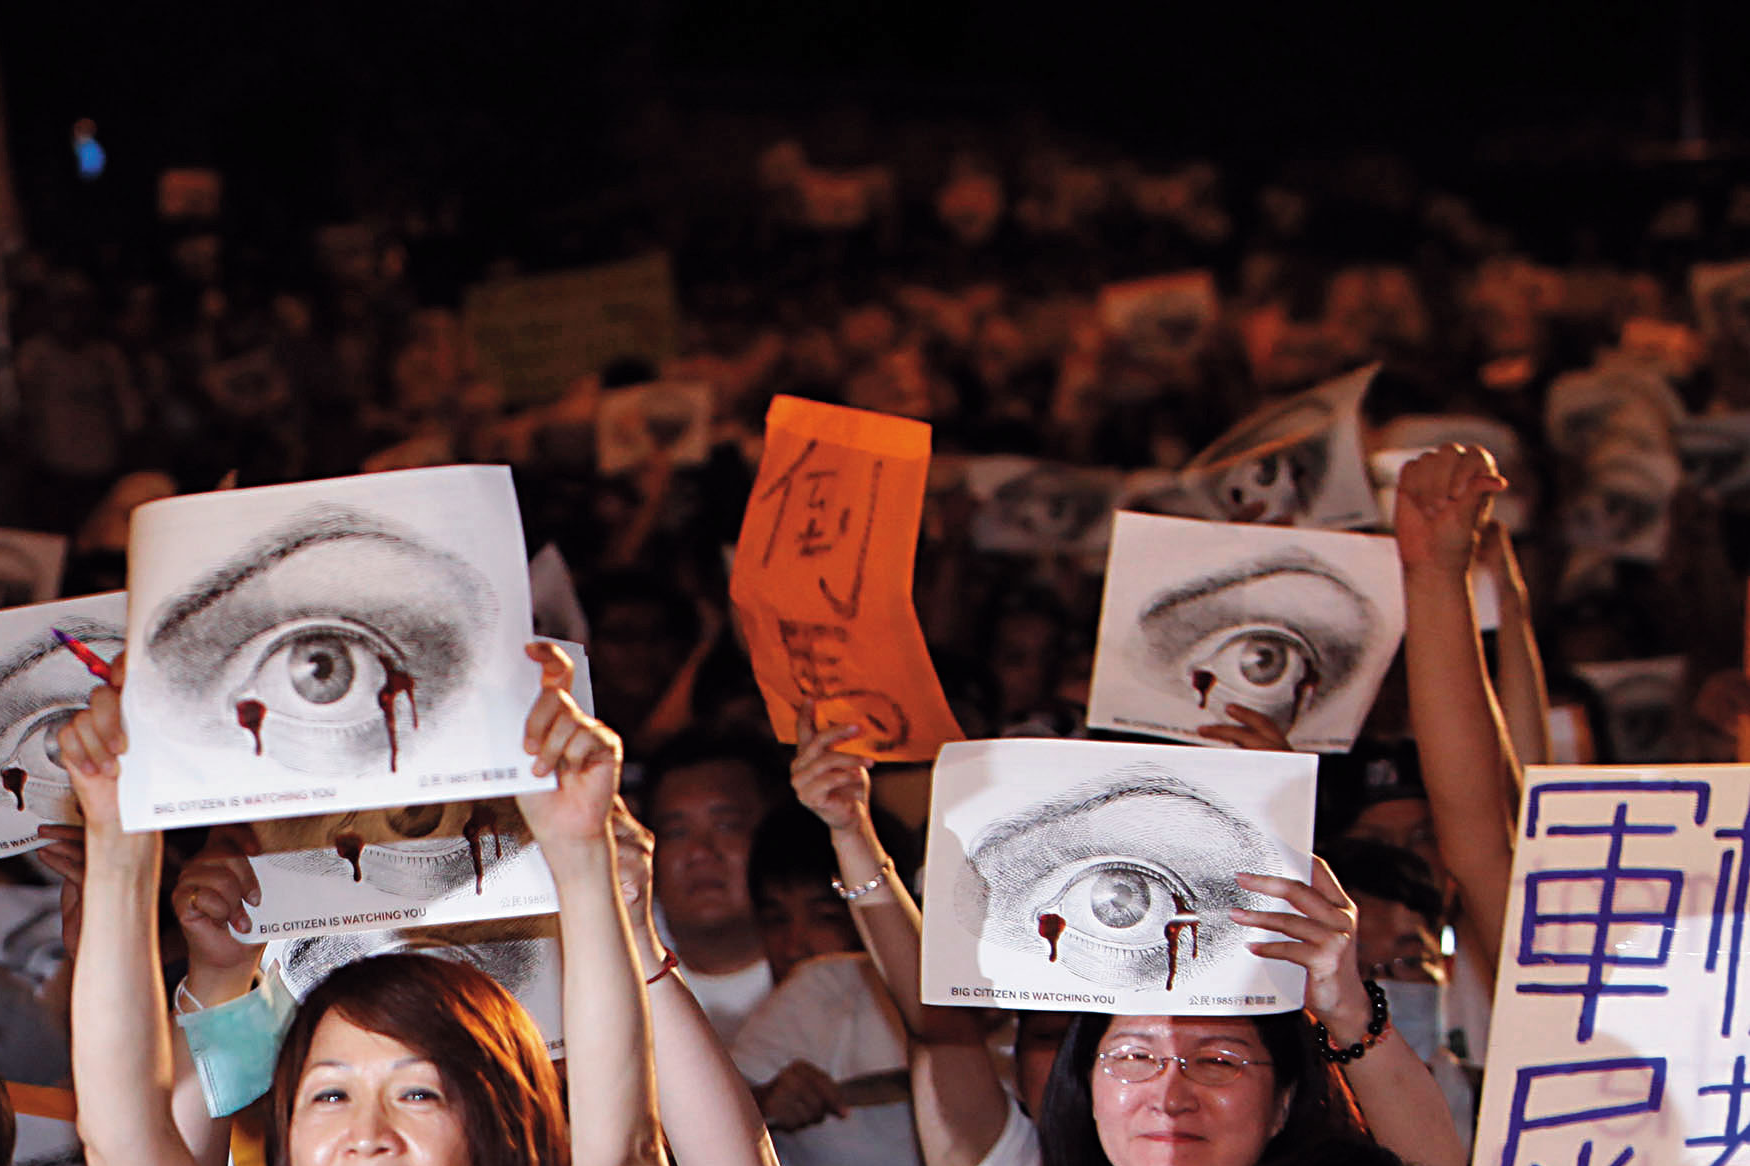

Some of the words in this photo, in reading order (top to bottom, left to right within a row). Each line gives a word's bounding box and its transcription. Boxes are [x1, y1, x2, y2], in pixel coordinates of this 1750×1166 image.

[154, 802, 176, 815] BIG
[179, 798, 226, 813] CITIZEN
[229, 796, 241, 807] IS
[244, 789, 308, 805] WATCHING
[311, 787, 337, 799] YOU
[259, 921, 281, 935] BIG
[282, 917, 327, 933] CITIZEN
[329, 916, 341, 928] IS
[342, 910, 402, 927] WATCHING
[403, 907, 428, 920] YOU
[951, 986, 971, 998] BIG
[973, 987, 1017, 999] CITIZEN
[1019, 989, 1030, 1000] IS
[1032, 990, 1091, 1004] WATCHING
[1093, 993, 1116, 1005] YOU
